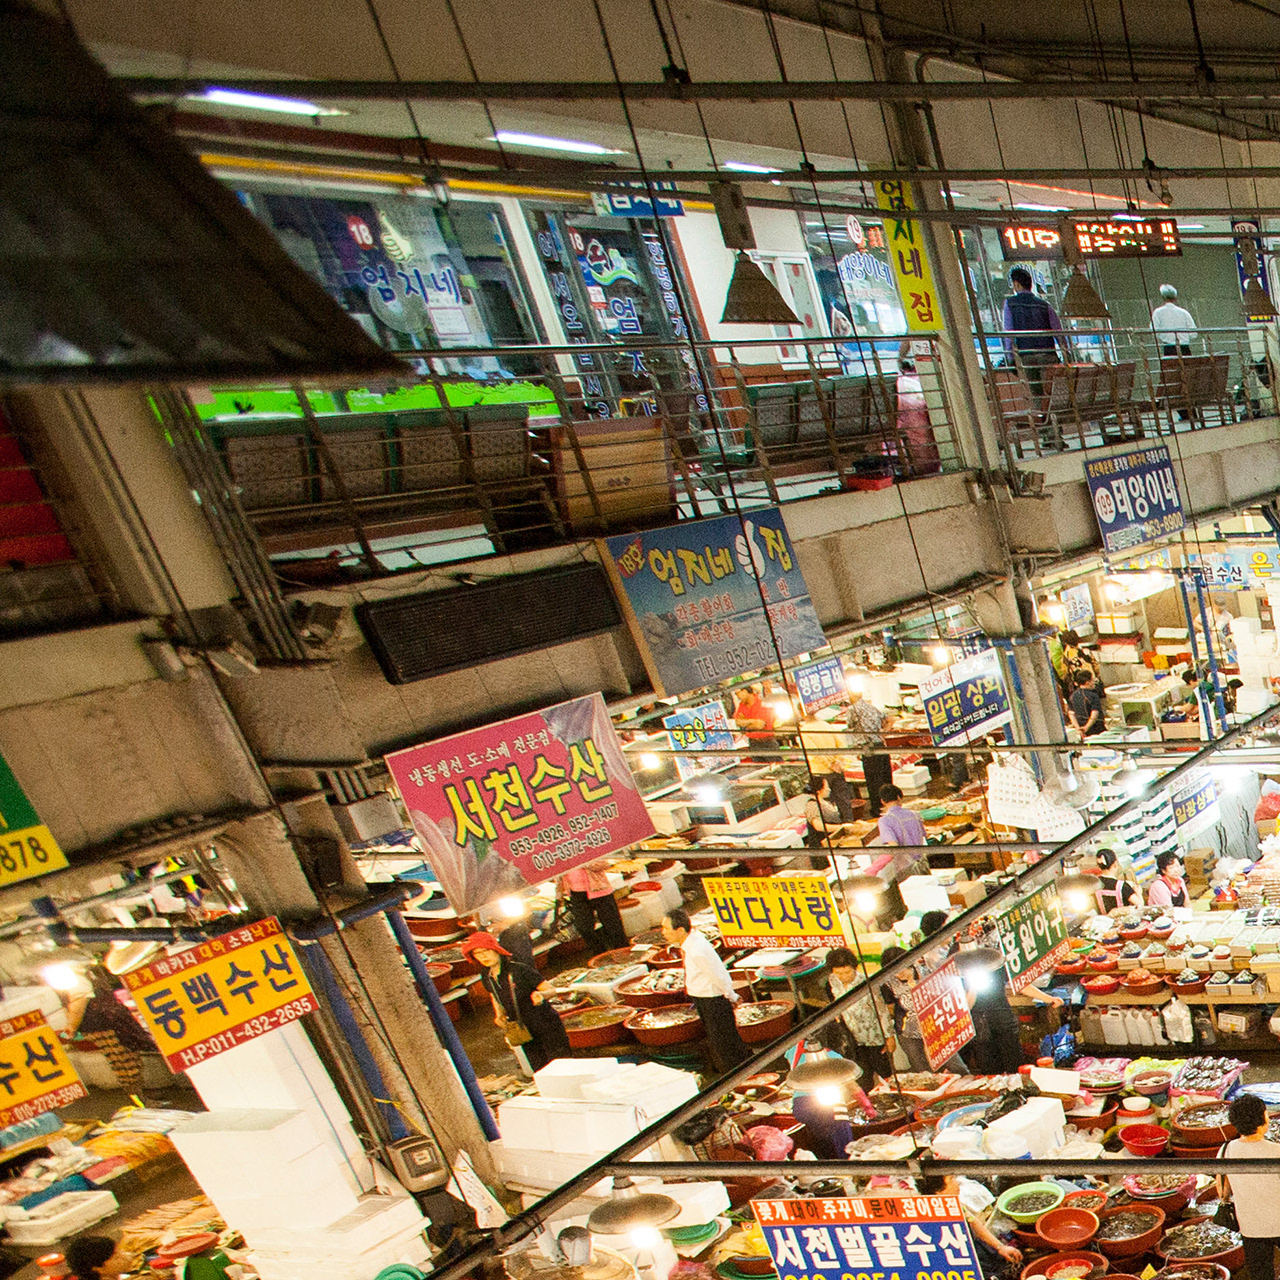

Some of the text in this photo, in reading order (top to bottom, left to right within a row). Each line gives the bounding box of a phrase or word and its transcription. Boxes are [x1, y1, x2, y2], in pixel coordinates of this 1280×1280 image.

[349, 216, 371, 247] 18
[361, 265, 461, 304] 엄지네
[1110, 467, 1180, 522] 태양이네
[648, 545, 736, 596] 엄지네
[759, 525, 793, 572] 집
[513, 729, 551, 755] 전문점
[442, 737, 614, 849] 서천수산
[568, 802, 620, 835] 952-1407
[712, 896, 834, 932] 바다사랑
[143, 942, 299, 1040] 동백수산
[772, 1223, 973, 1270] 서천벌꿀수산
